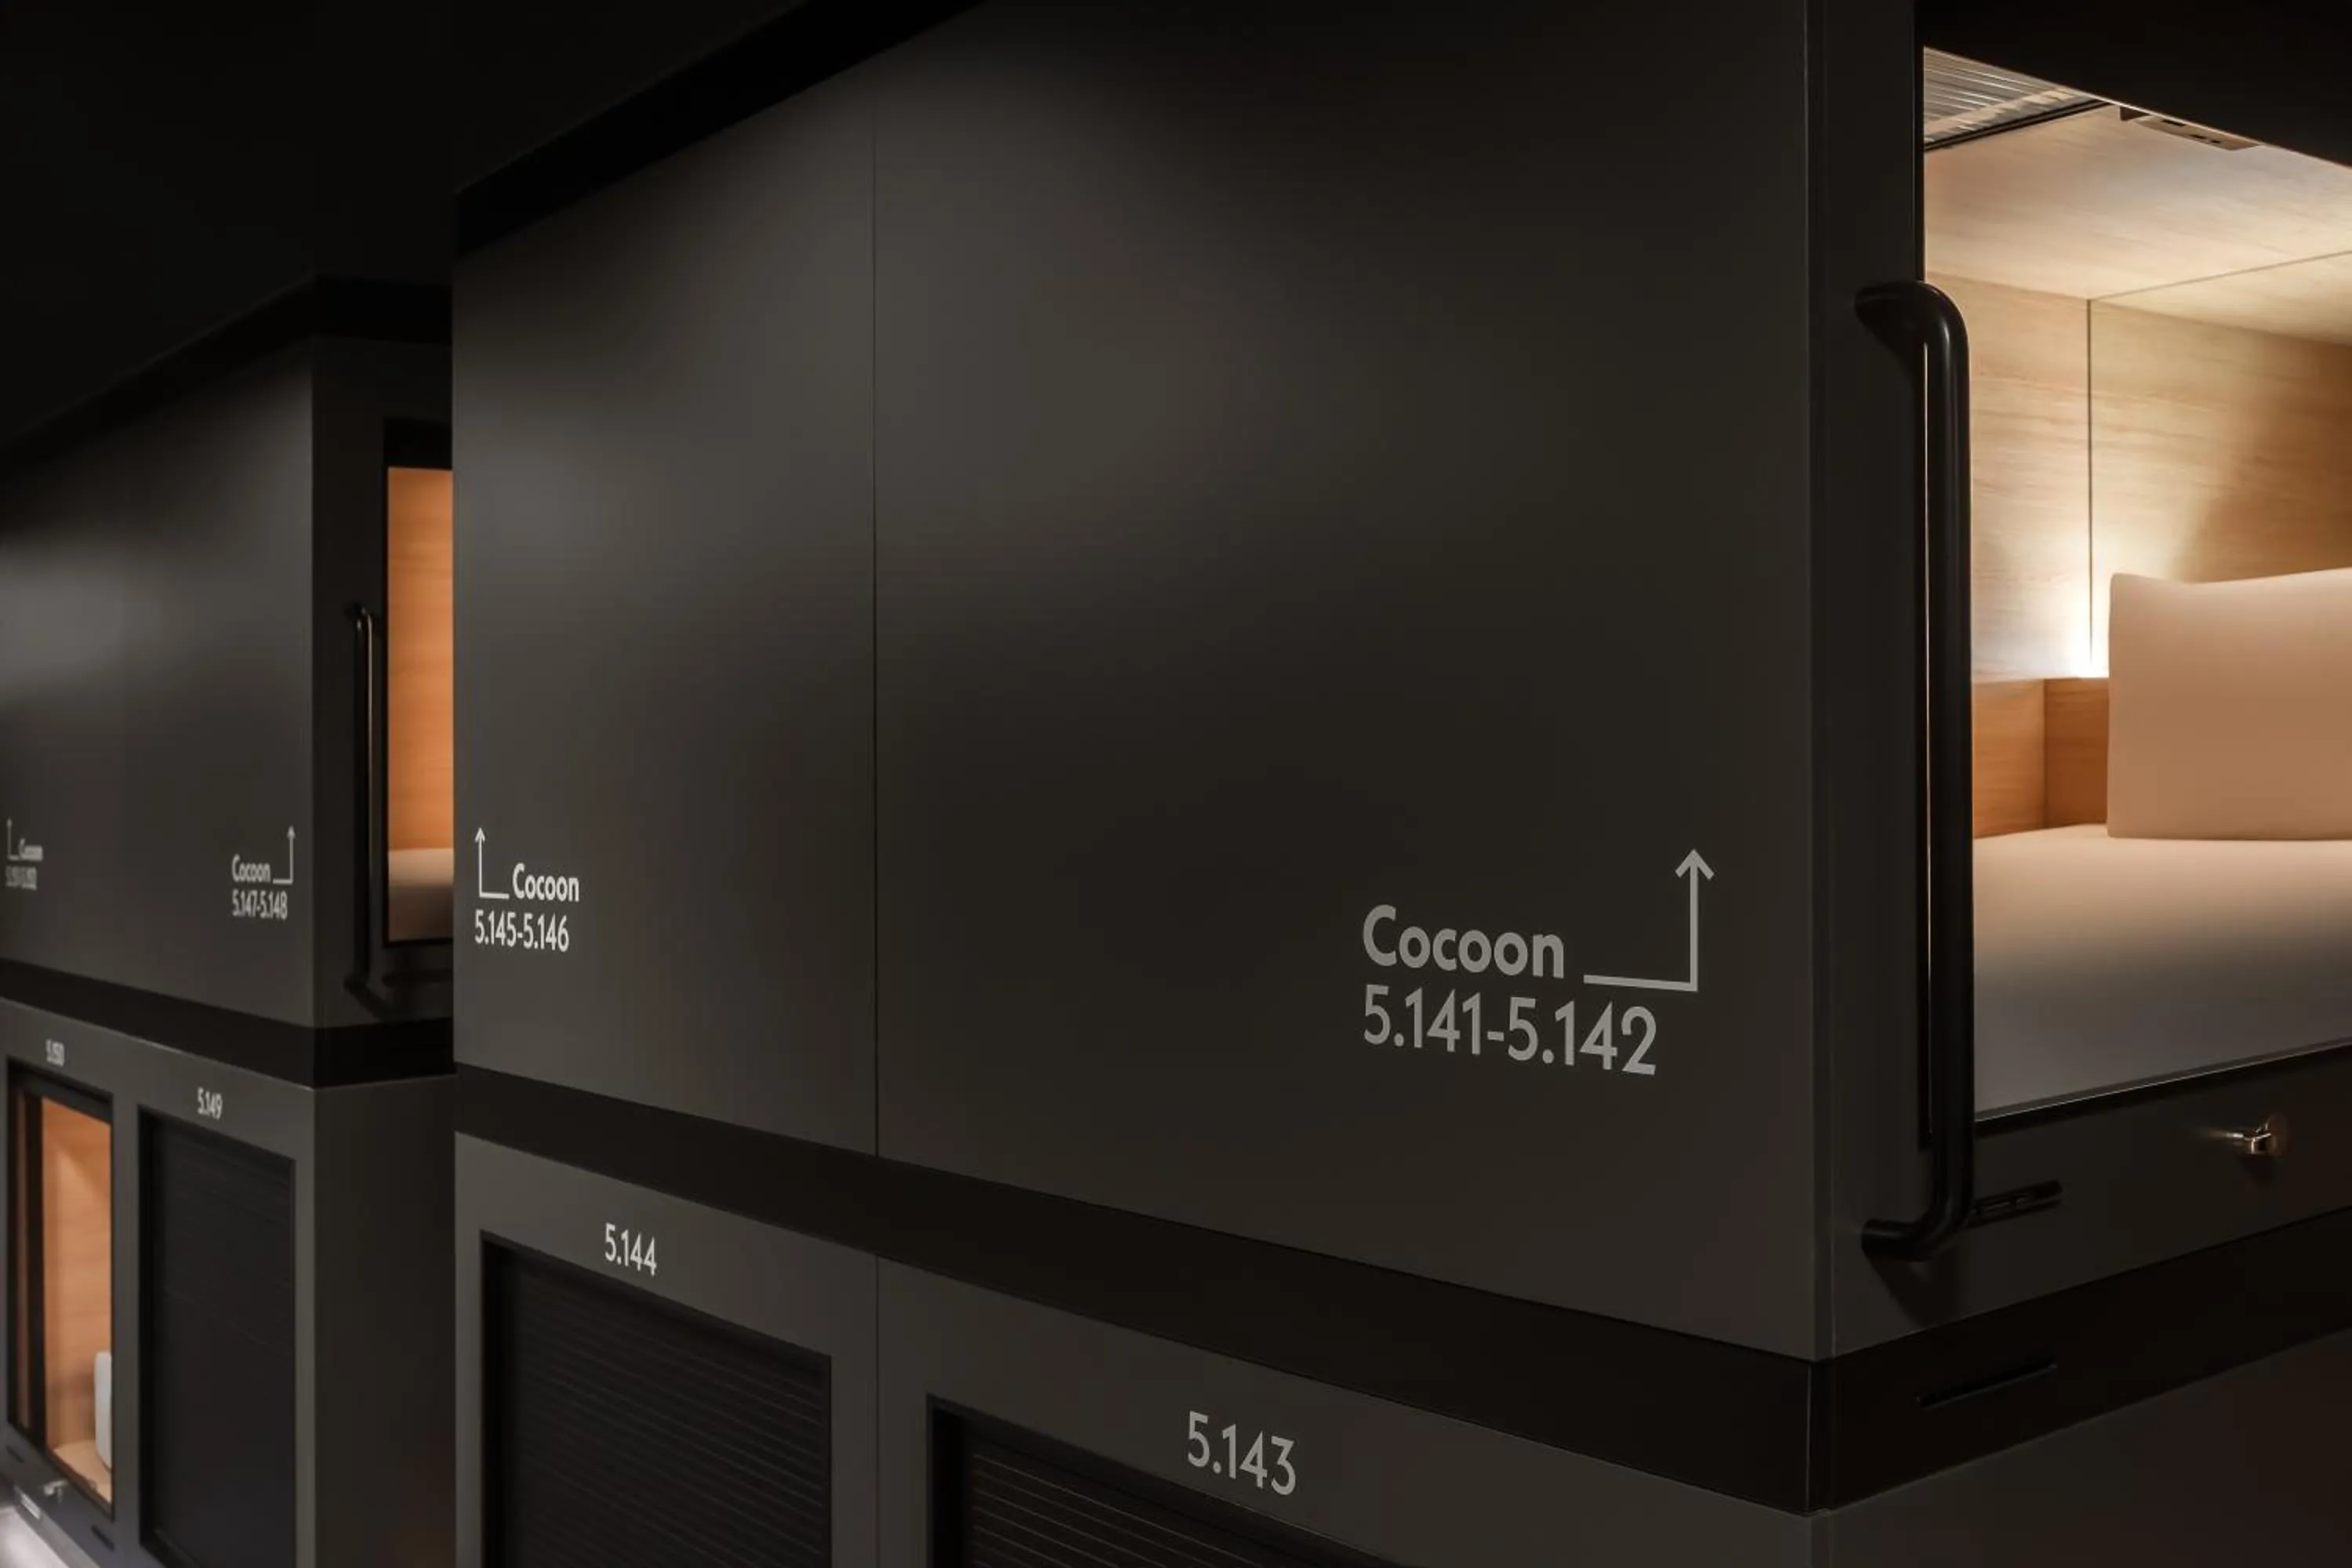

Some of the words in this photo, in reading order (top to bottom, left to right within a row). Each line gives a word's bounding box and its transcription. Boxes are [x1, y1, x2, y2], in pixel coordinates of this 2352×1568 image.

[231, 854, 270, 882] Cocoon
[512, 862, 579, 902] Cocoon
[474, 909, 570, 953] 5.145-5.146
[1363, 904, 1565, 978] Cocoon
[1363, 983, 1656, 1076] 5.141-5.142
[604, 1221, 657, 1276] 5.144
[1188, 1410, 1296, 1496] 5.143
